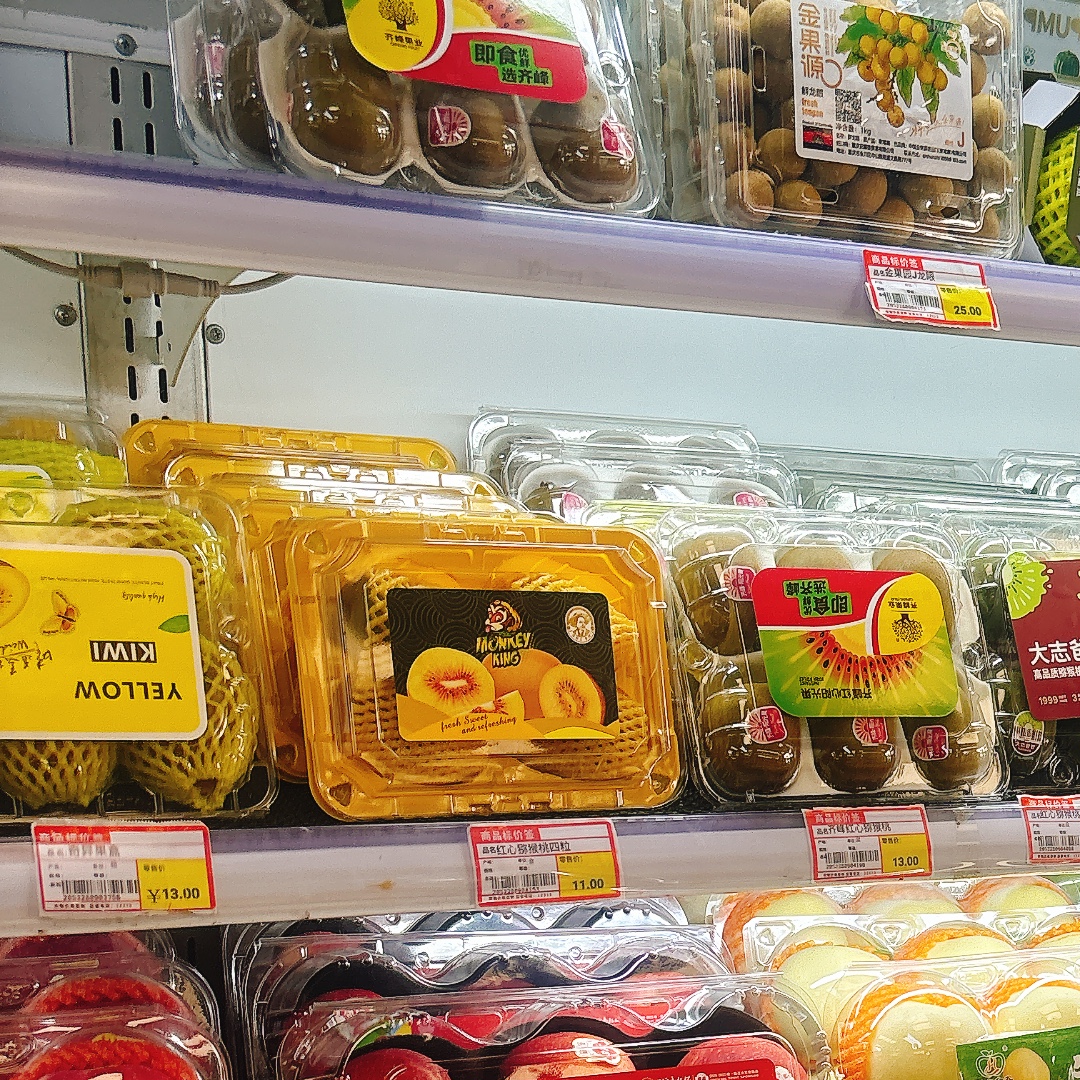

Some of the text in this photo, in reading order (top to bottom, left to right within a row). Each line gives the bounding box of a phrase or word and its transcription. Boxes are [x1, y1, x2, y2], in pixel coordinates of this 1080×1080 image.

[799, 3, 824, 79] 金果源
[474, 42, 518, 66] 即食
[501, 67, 550, 85] 选齐峰
[871, 254, 919, 268] 商品标价签
[953, 305, 982, 316] 25.00
[785, 581, 828, 596] 选齐峰
[813, 594, 848, 615] 即食
[476, 631, 534, 654] MONKEY
[92, 642, 156, 662] KIWI
[491, 651, 521, 668] KING
[75, 681, 182, 701] YELLOW
[814, 811, 861, 823] 商品标价签
[480, 829, 535, 841] 商品标价签
[892, 856, 919, 867] 13.00
[572, 878, 604, 891] 11.00
[147, 887, 201, 904] ¥13.00
